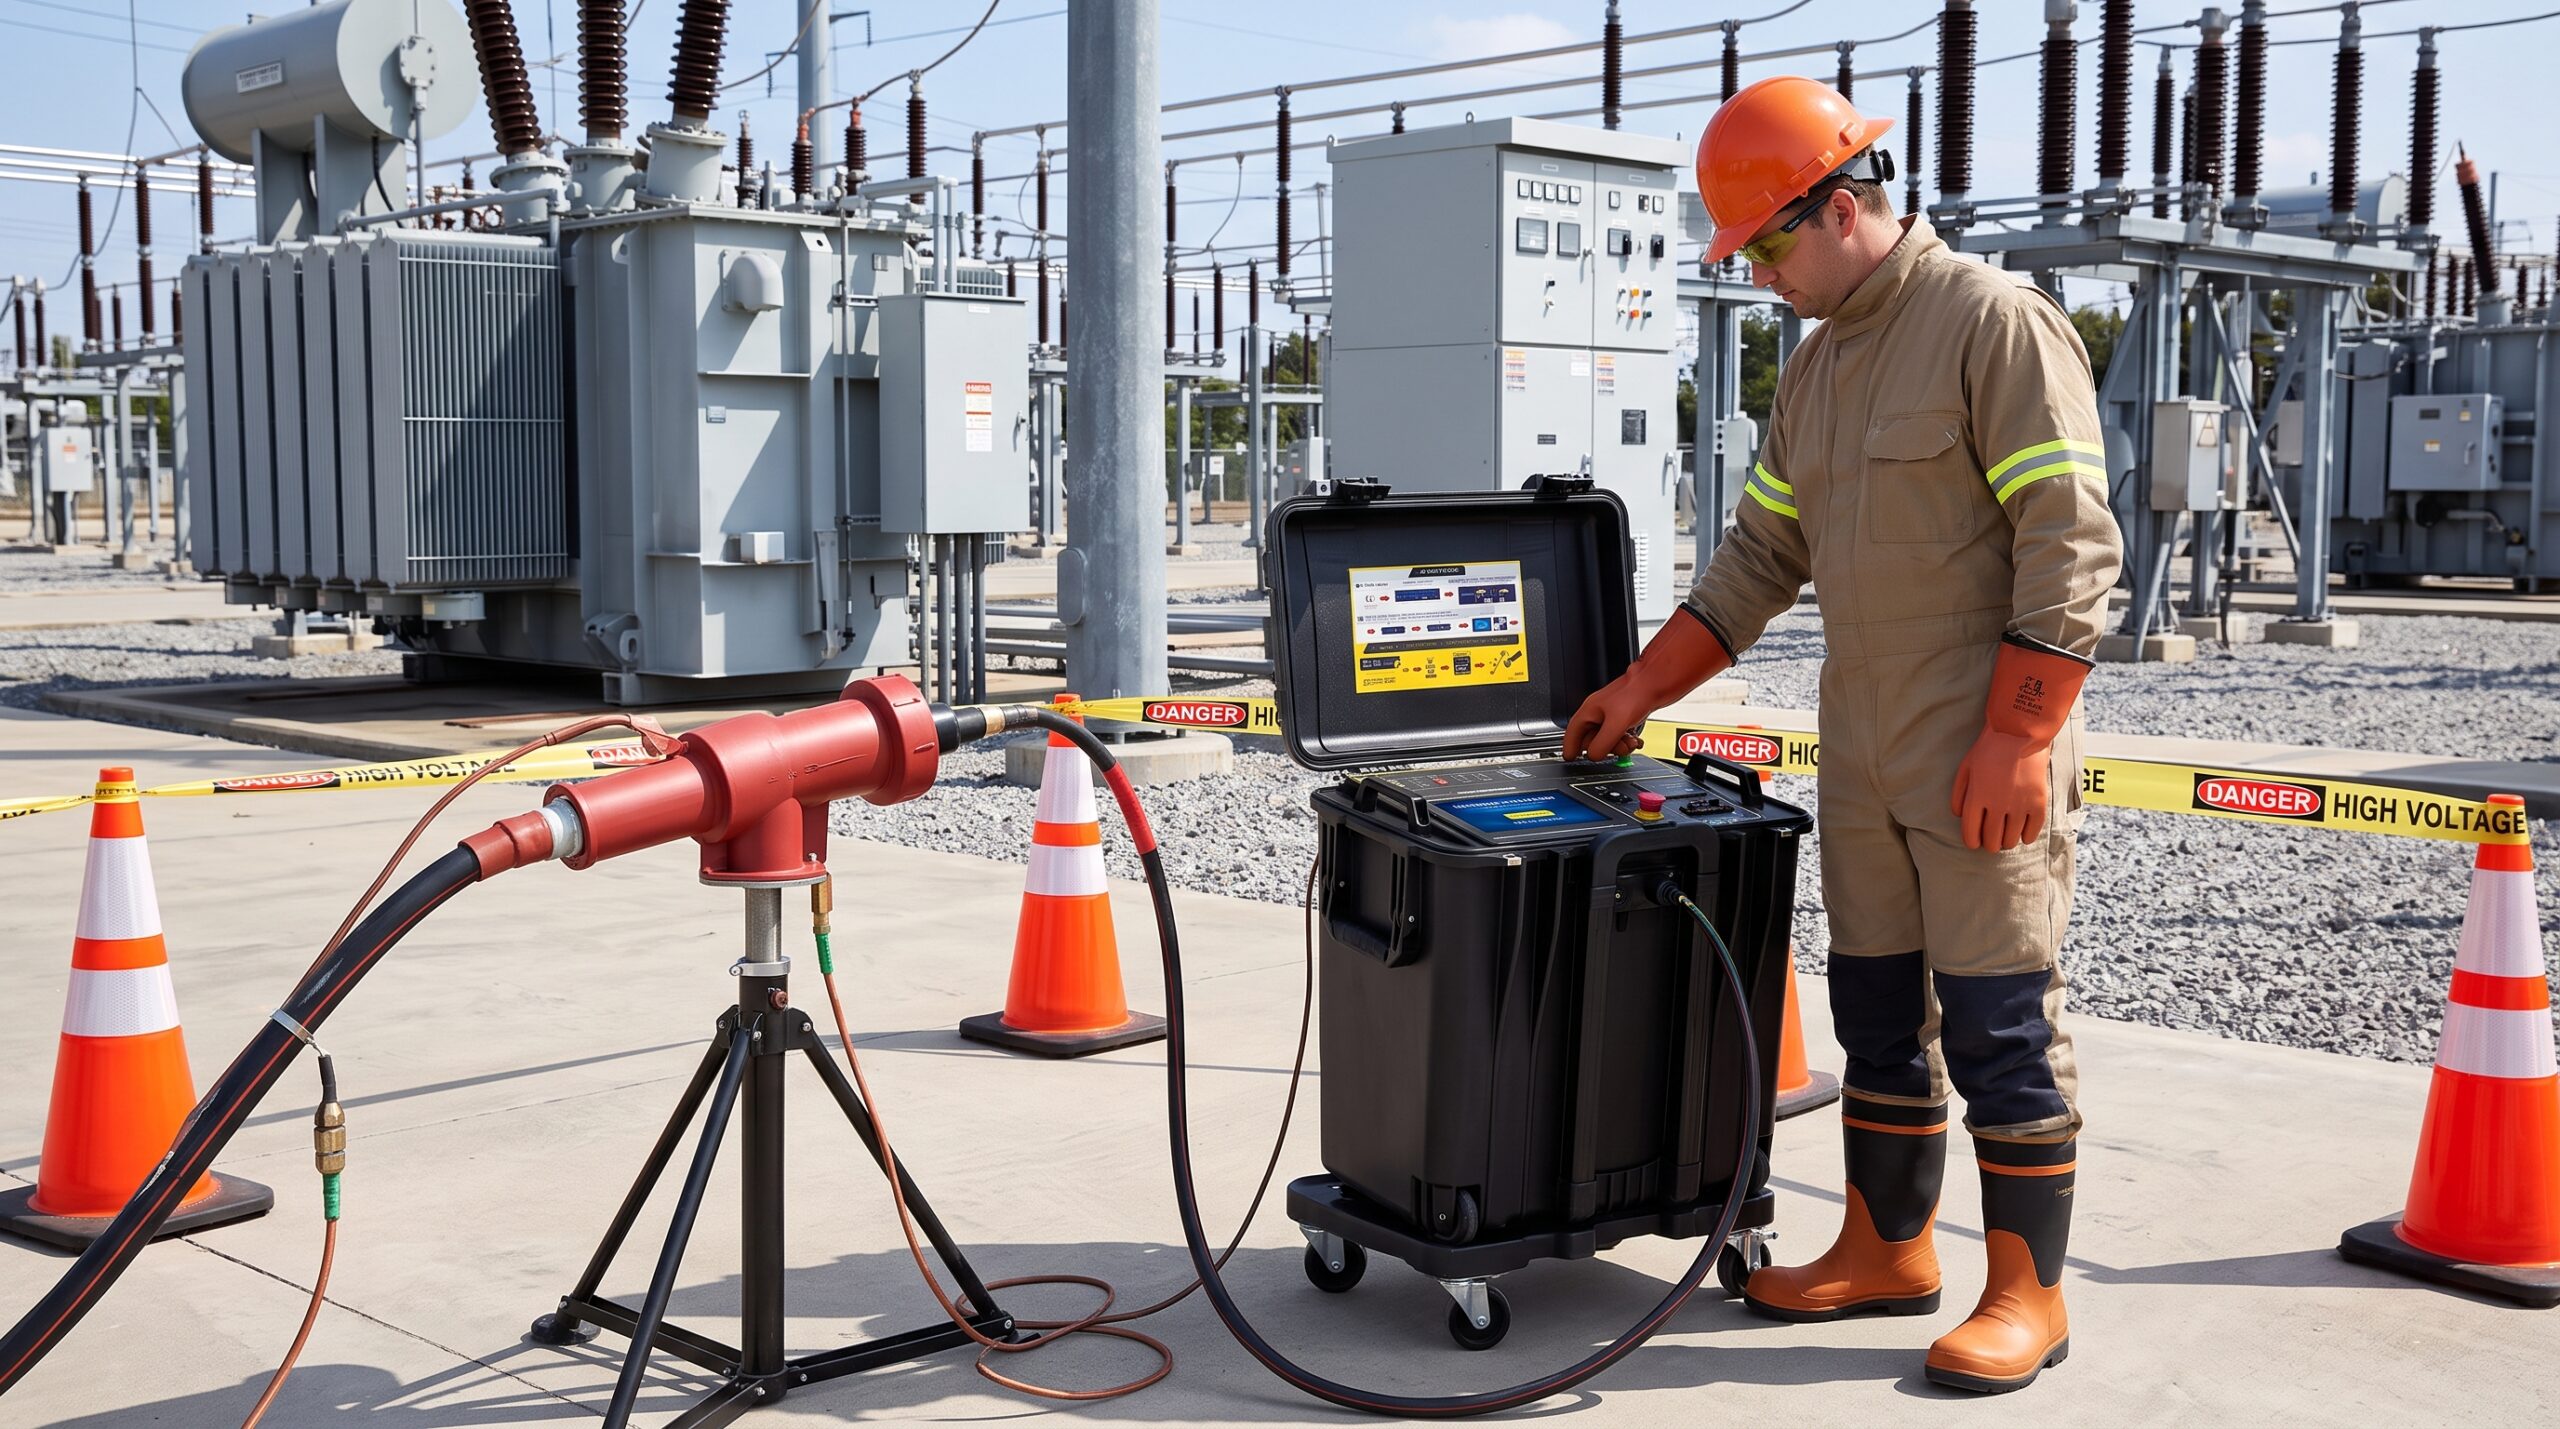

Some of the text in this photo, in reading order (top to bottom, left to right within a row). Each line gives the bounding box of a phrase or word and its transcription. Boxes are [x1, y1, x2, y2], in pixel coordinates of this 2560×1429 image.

[1152, 705, 1238, 722] DANGER
[1686, 735, 1772, 760] DANGER
[344, 767, 404, 783] HIGH
[2207, 782, 2526, 835] DANGER HIGH VOLTAGE
